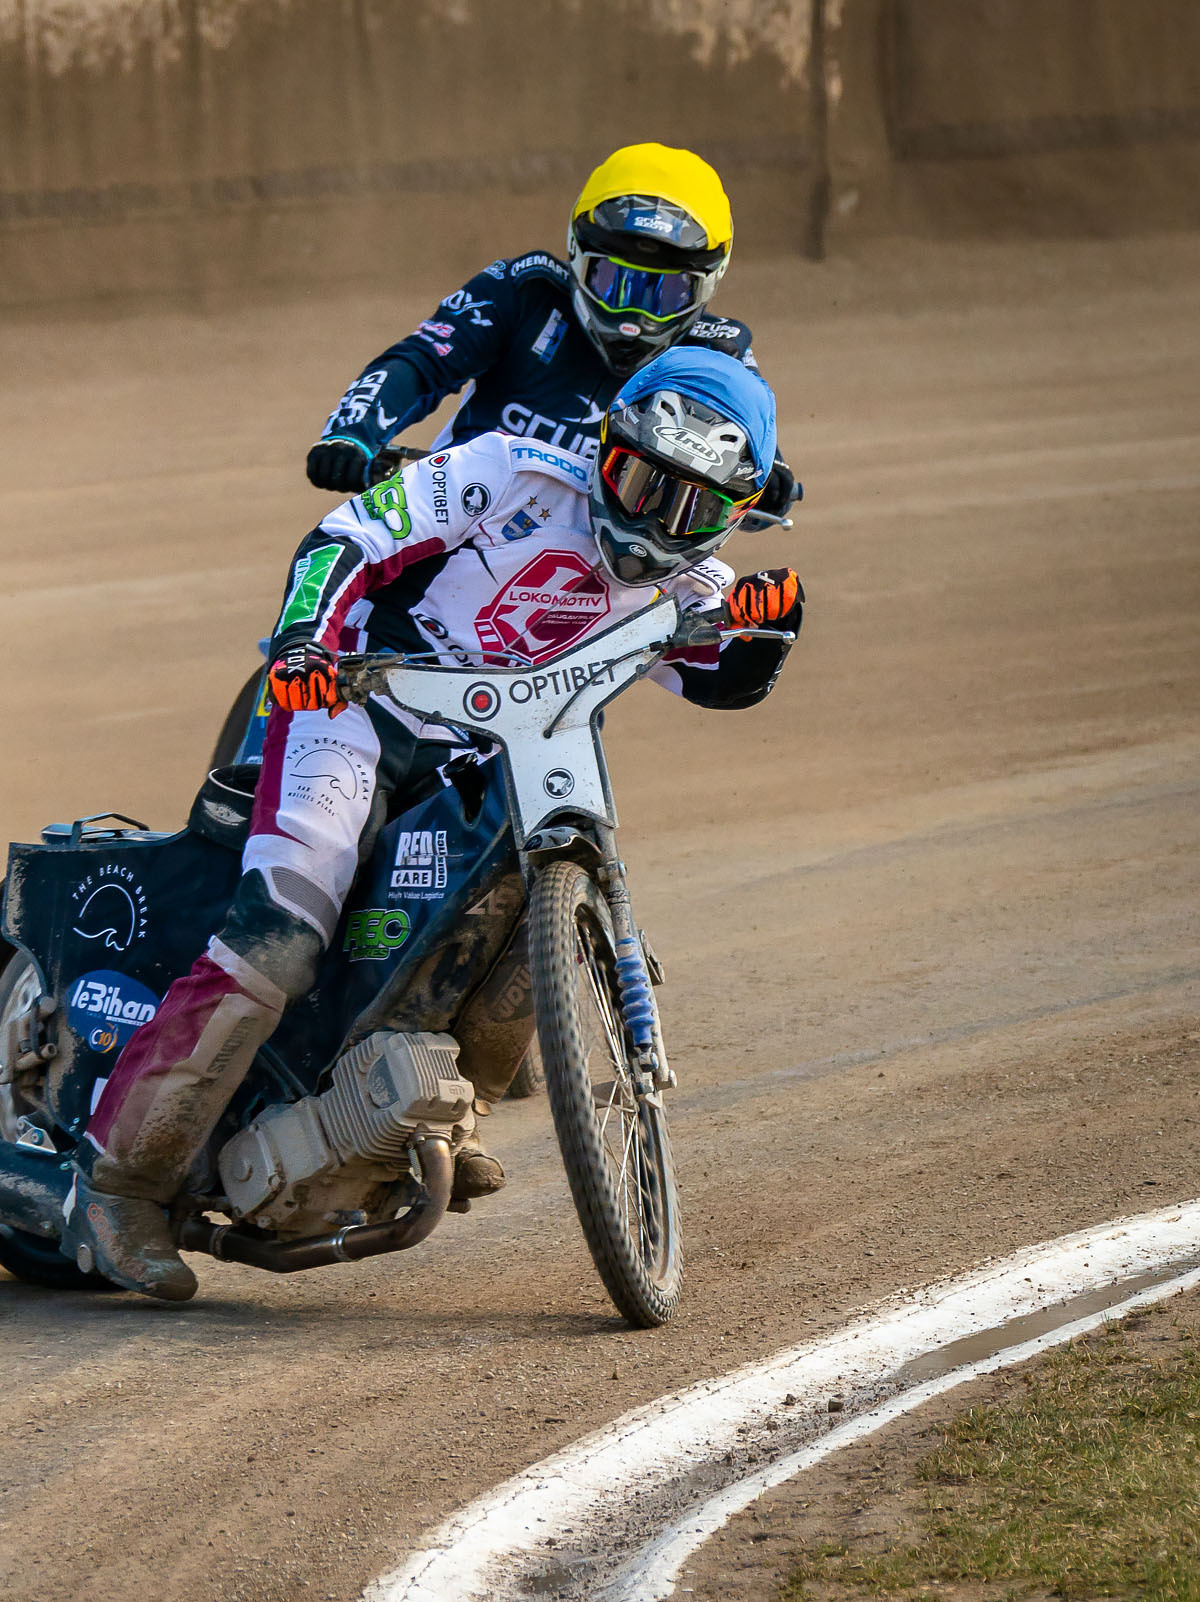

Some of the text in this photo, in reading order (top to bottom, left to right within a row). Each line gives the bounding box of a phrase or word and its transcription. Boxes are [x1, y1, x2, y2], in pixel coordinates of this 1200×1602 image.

[660, 429, 716, 460] Arai
[511, 447, 587, 482] TRODO
[432, 470, 449, 526] OPTIBET
[509, 591, 603, 607] LOKOMOTIV
[287, 648, 305, 674] FOX
[509, 658, 615, 704] OPTIBET
[286, 743, 306, 760] THE
[314, 737, 354, 757] BEACH
[395, 831, 433, 885] RED CARE
[72, 864, 149, 938] THE BEACH BREAK
